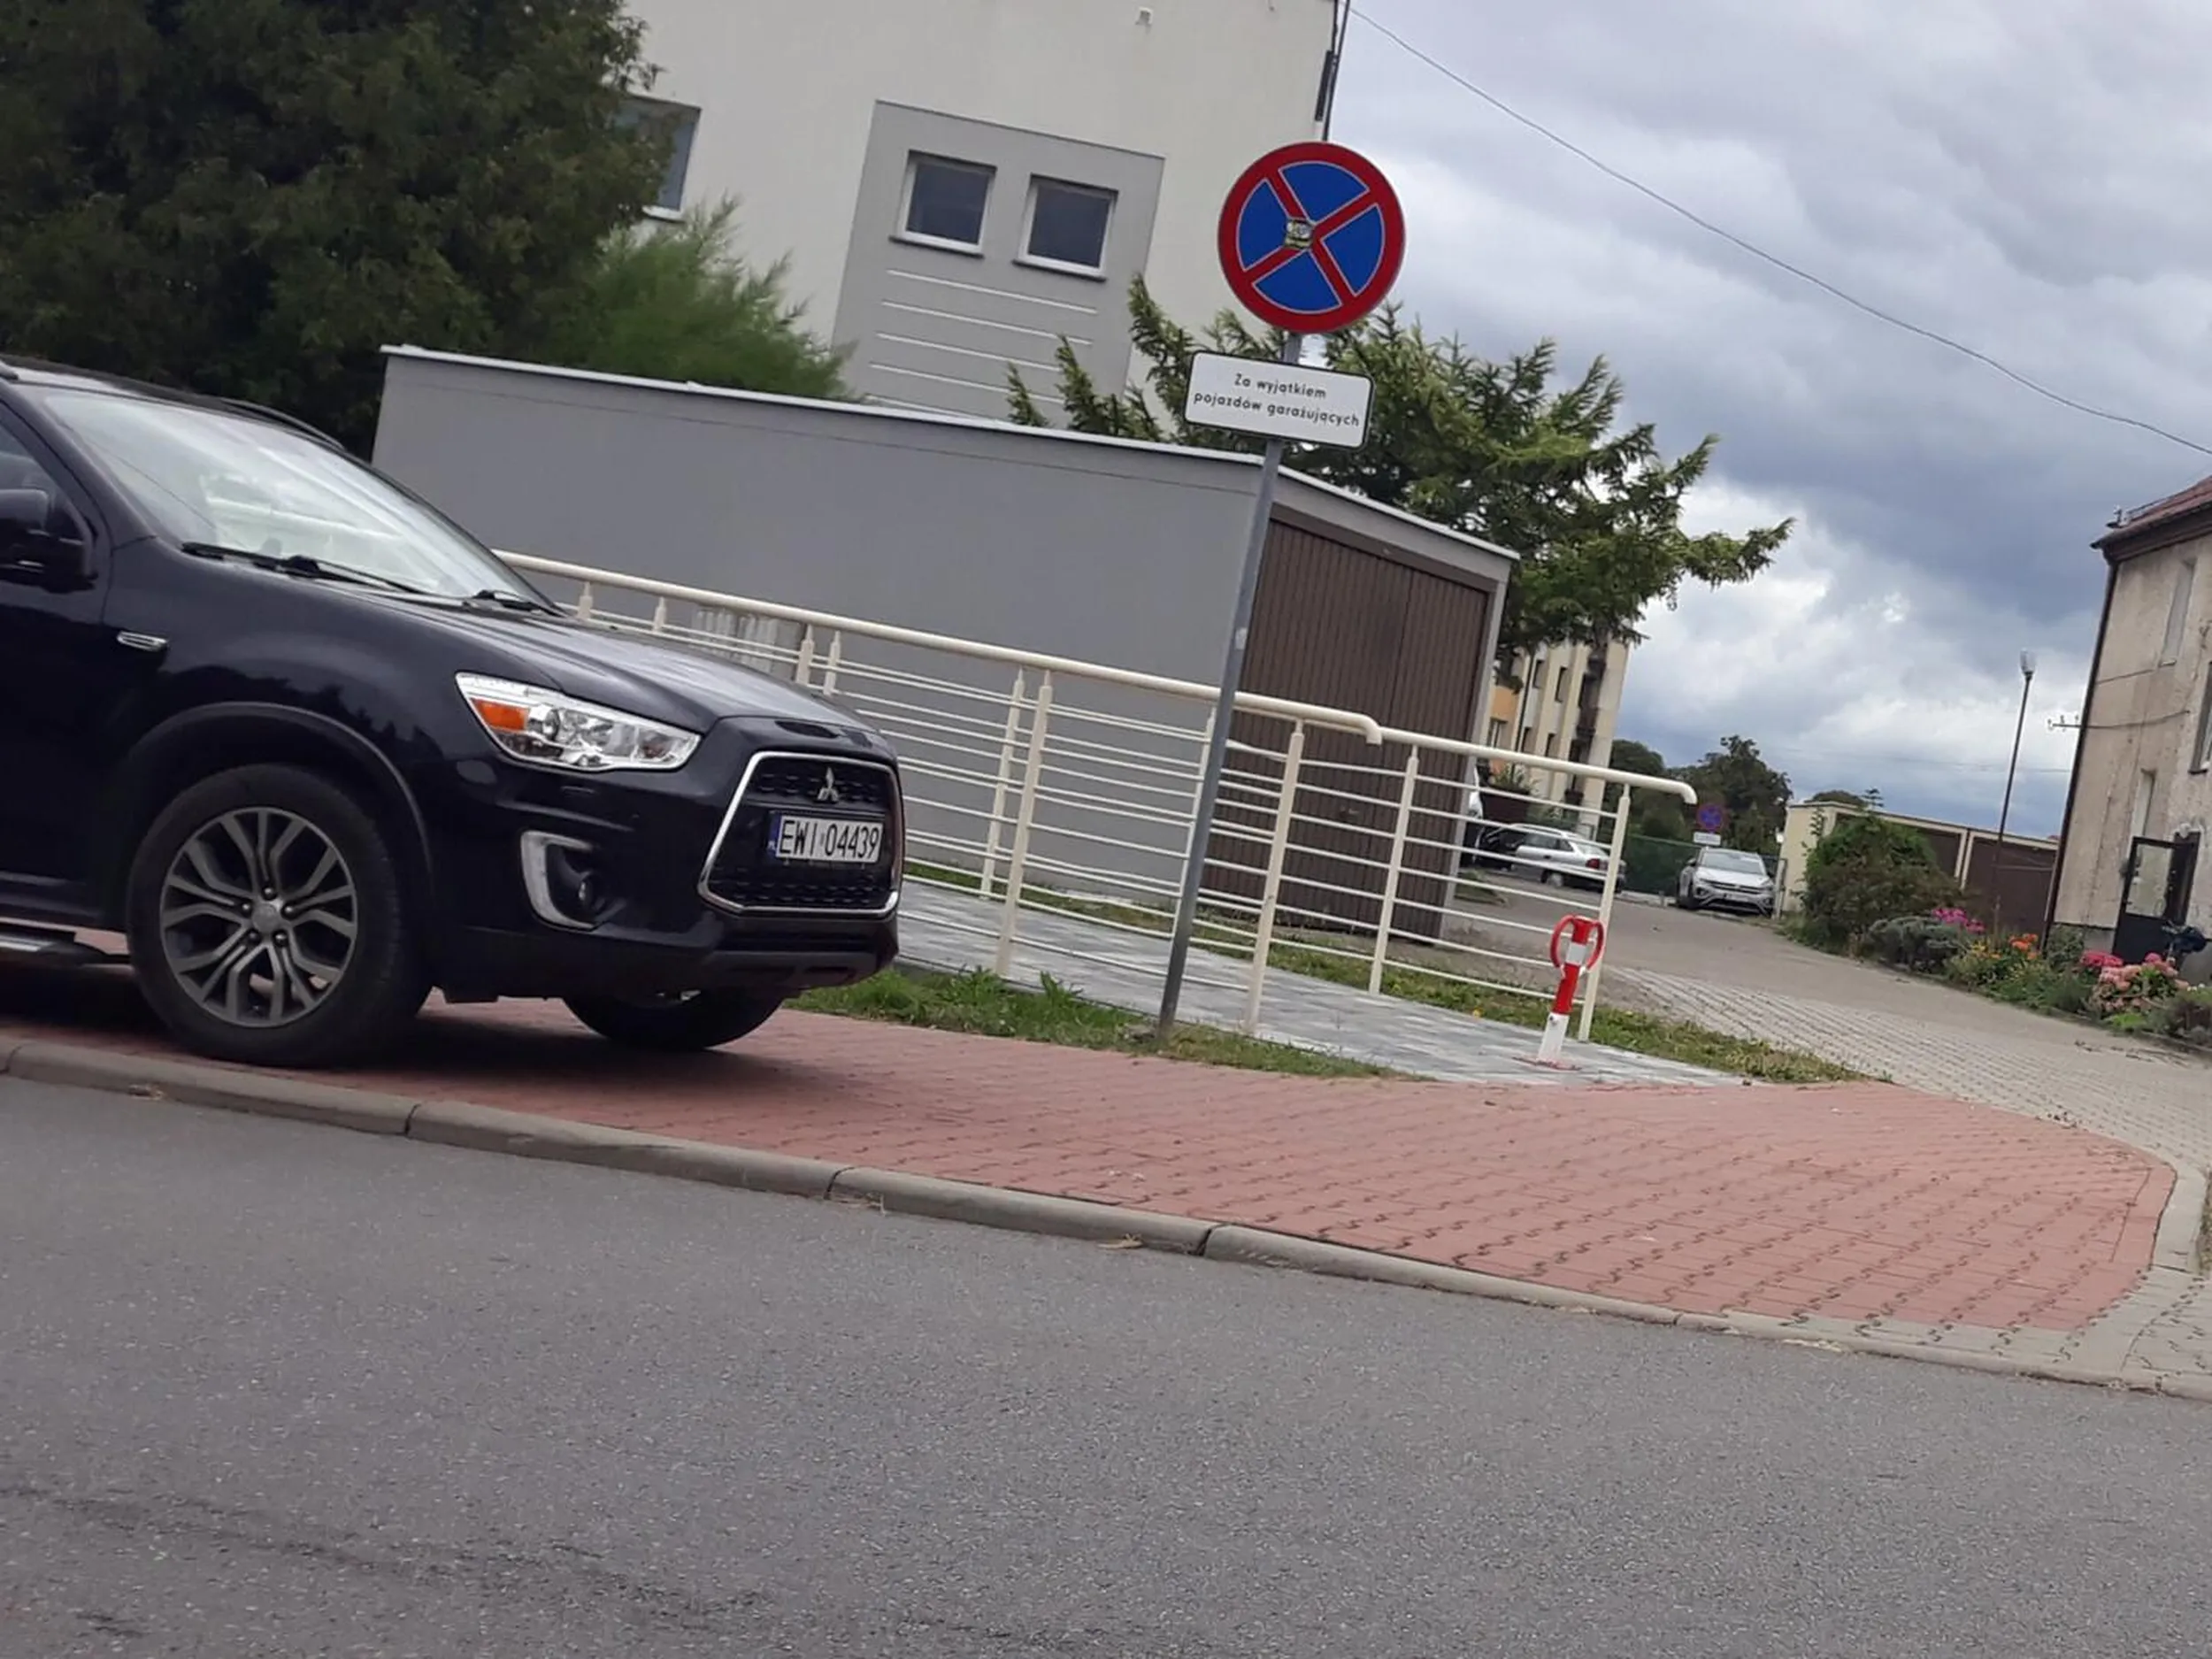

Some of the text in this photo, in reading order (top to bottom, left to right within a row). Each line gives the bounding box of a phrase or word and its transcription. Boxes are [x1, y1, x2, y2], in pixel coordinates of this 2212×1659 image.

[1234, 373, 1327, 398] Za wyjątkiem
[1193, 391, 1360, 426] pojazdów garażujących
[780, 819, 879, 859] EWI 04439
